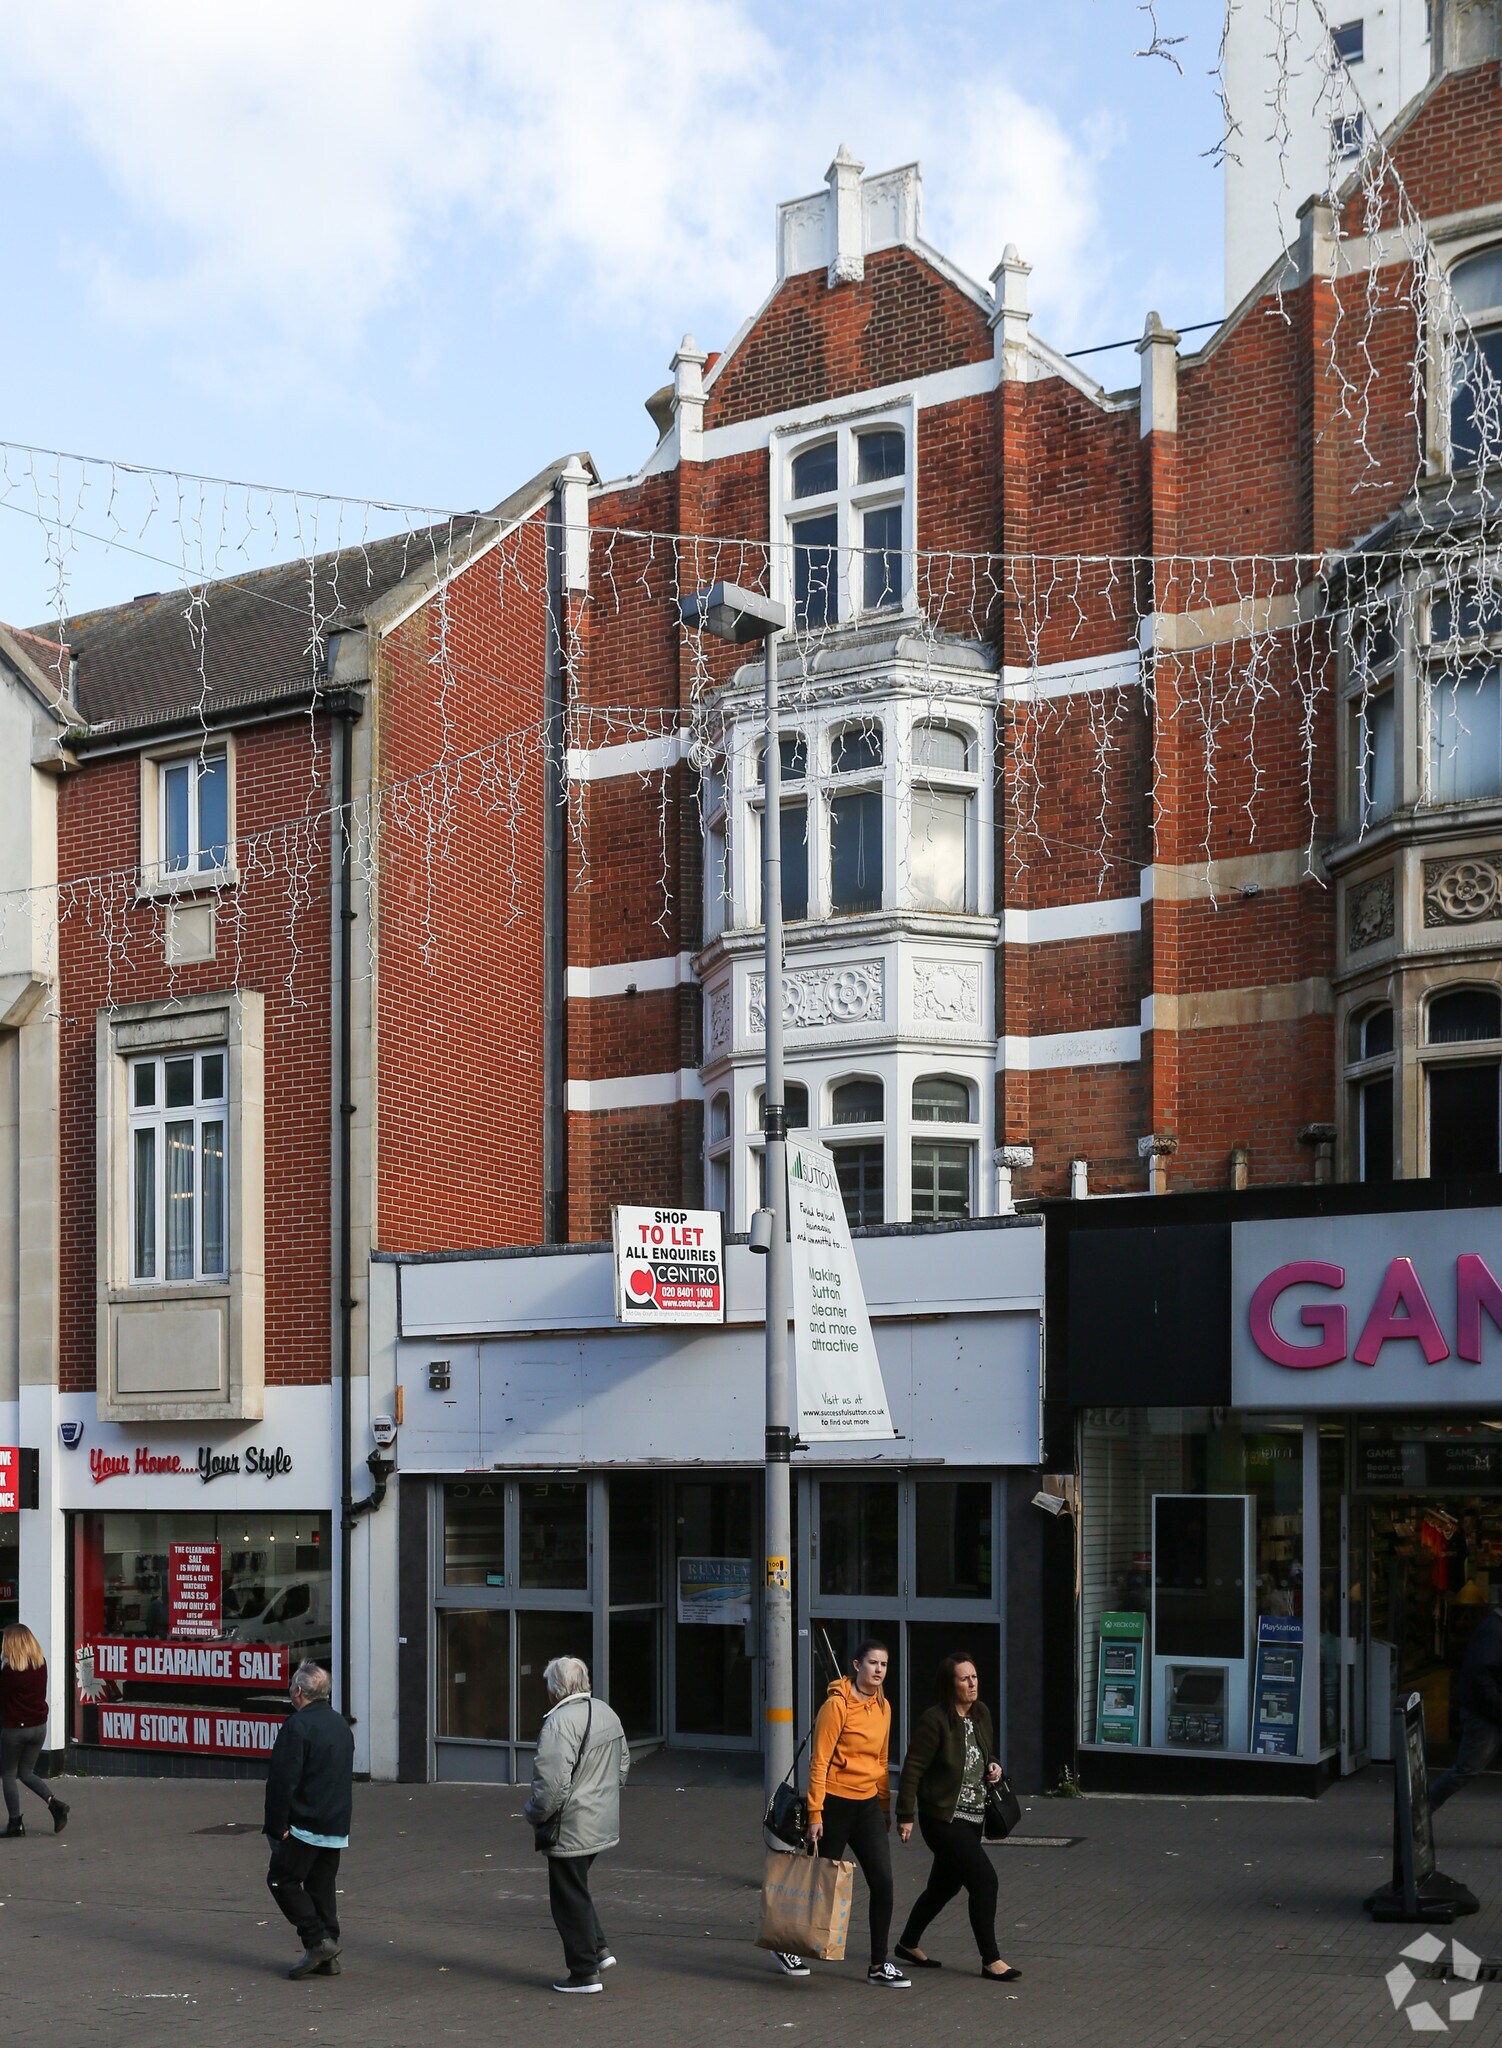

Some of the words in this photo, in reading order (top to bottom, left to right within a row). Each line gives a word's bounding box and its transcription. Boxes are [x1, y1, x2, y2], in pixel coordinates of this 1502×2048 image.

[803, 1163, 838, 1191] SUTTON
[654, 1211, 687, 1225] SHOP
[638, 1224, 664, 1245] TO
[671, 1226, 704, 1247] LET
[797, 1231, 807, 1241] and
[626, 1246, 648, 1259] ALL
[652, 1247, 716, 1262] ENQUIRIES
[808, 1266, 841, 1287] Making
[661, 1286, 676, 1297] 020
[677, 1287, 694, 1298] 8401
[696, 1287, 713, 1299] 1000
[812, 1284, 841, 1300] Sutton
[662, 1299, 714, 1309] www.centro.plc.uk
[811, 1303, 848, 1318] cleaner
[809, 1321, 826, 1334] and
[828, 1324, 857, 1336] more
[811, 1338, 859, 1353] attractive
[821, 1392, 839, 1405] Visit
[842, 1397, 852, 1405] us
[854, 1393, 863, 1405] at
[802, 1408, 885, 1417] www.successfulsutton.co.uk
[829, 1418, 841, 1426] find
[1366, 1449, 1396, 1458] GAME
[90, 1447, 130, 1485] Your
[245, 1446, 293, 1480] Style
[174, 1546, 185, 1554] THE
[185, 1546, 216, 1554] CLEARANCE
[188, 1555, 202, 1564] SALE
[180, 1564, 186, 1572] IS
[187, 1564, 201, 1572] NOW
[201, 1564, 210, 1572] ON
[688, 1563, 748, 1577] RUMSEY
[180, 1591, 195, 1600] WAS
[195, 1591, 209, 1600] £50
[173, 1601, 188, 1610] NOW
[189, 1602, 204, 1610] ONLY
[204, 1602, 216, 1611] £10
[171, 1627, 180, 1635] ALL
[180, 1627, 197, 1635] STOCK
[97, 1645, 128, 1673] THE
[134, 1646, 233, 1678] CLEARANCE
[239, 1651, 282, 1681] SALE
[102, 1711, 136, 1740] NEW
[140, 1714, 188, 1744] STOCK
[193, 1717, 210, 1745] IN
[768, 1883, 824, 1902] PRIMARK
